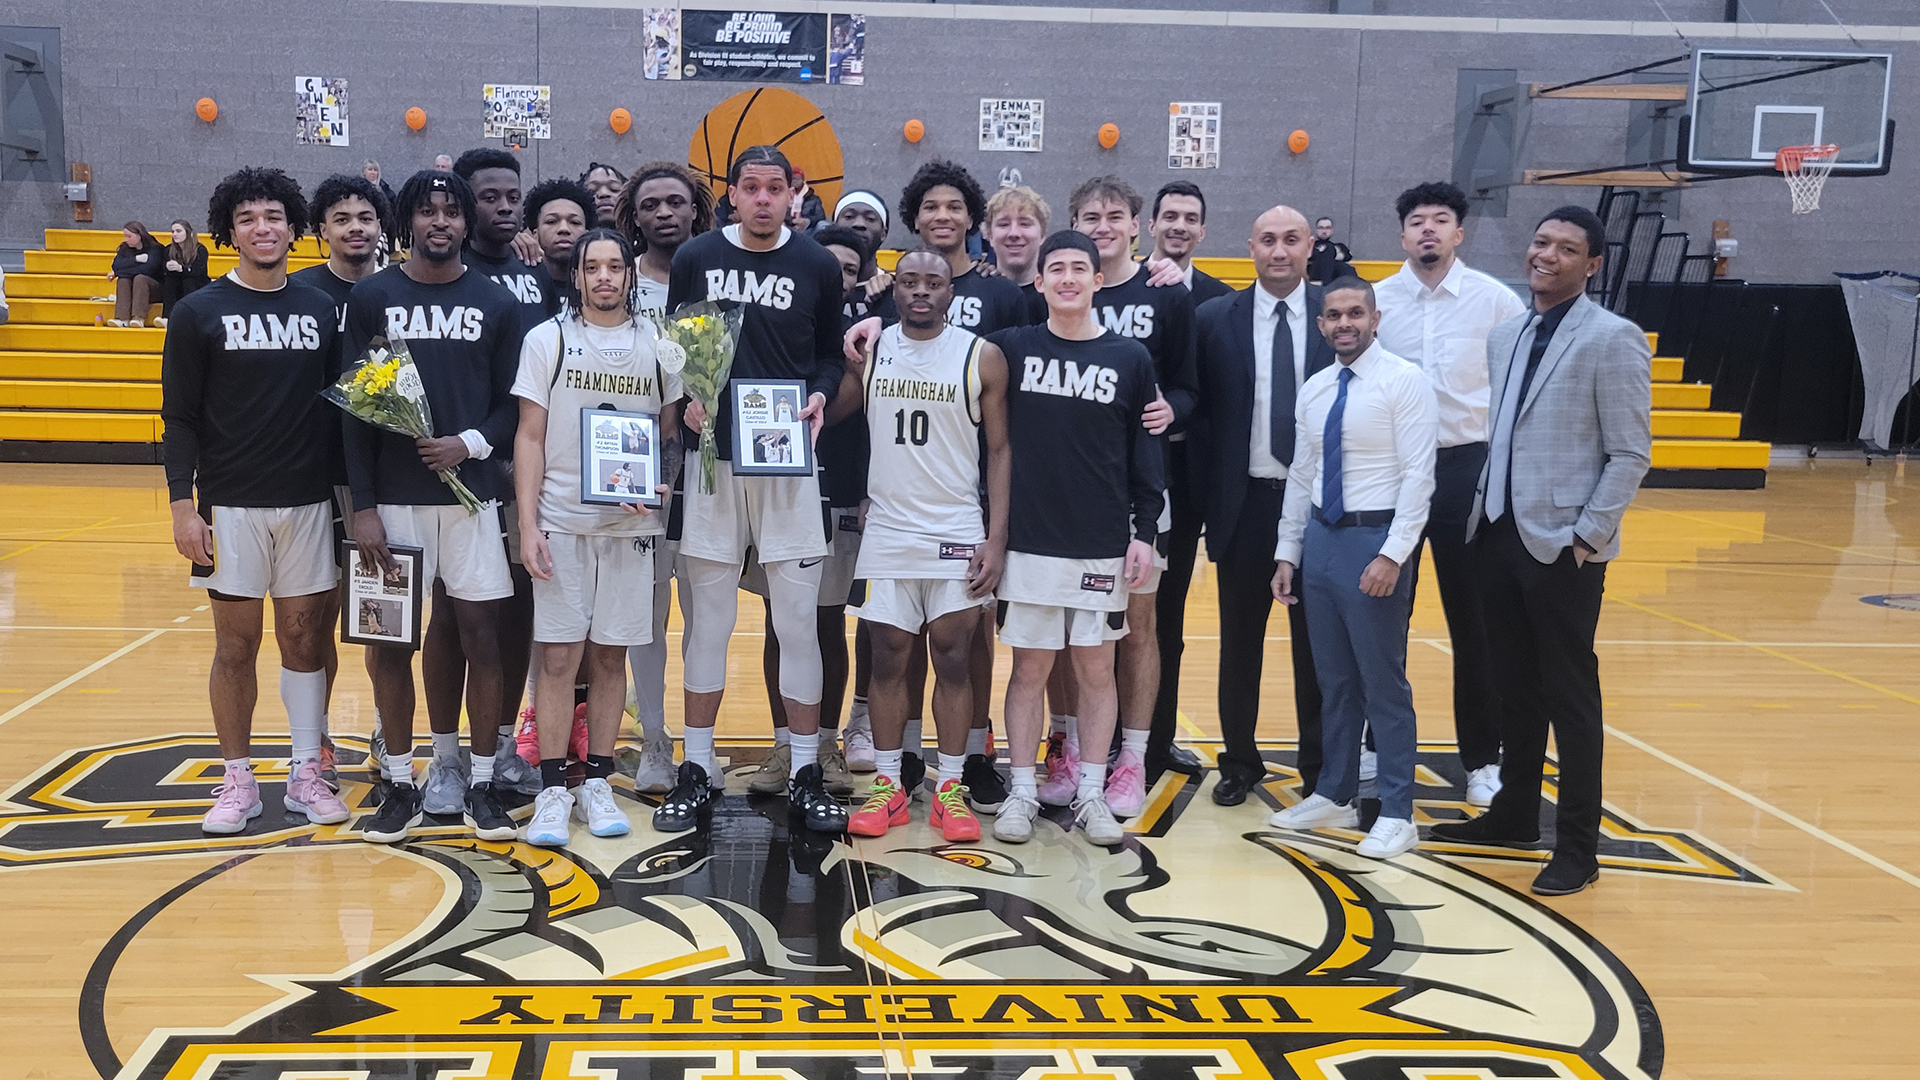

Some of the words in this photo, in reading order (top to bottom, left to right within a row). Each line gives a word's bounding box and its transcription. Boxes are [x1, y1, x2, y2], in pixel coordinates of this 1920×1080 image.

[725, 20, 741, 32] BE
[743, 21, 783, 33] PROUD
[731, 12, 746, 23] BE
[748, 12, 776, 23] LOUD
[715, 29, 733, 42] BE
[735, 30, 791, 44] POSITIVE
[305, 78, 343, 136] GWEN
[994, 101, 1031, 111] JENNA
[705, 268, 795, 310] RAMS
[384, 305, 484, 342] RAMS
[943, 295, 983, 327] MS
[221, 313, 321, 351] RAMS
[566, 369, 652, 397] FRAMINGHAM
[874, 376, 956, 403] FRAMINGHAM
[1019, 355, 1119, 405] RAMS
[595, 432, 618, 440] RAMS
[895, 408, 929, 446] 10
[459, 994, 1313, 1025] UNIVERSITY
